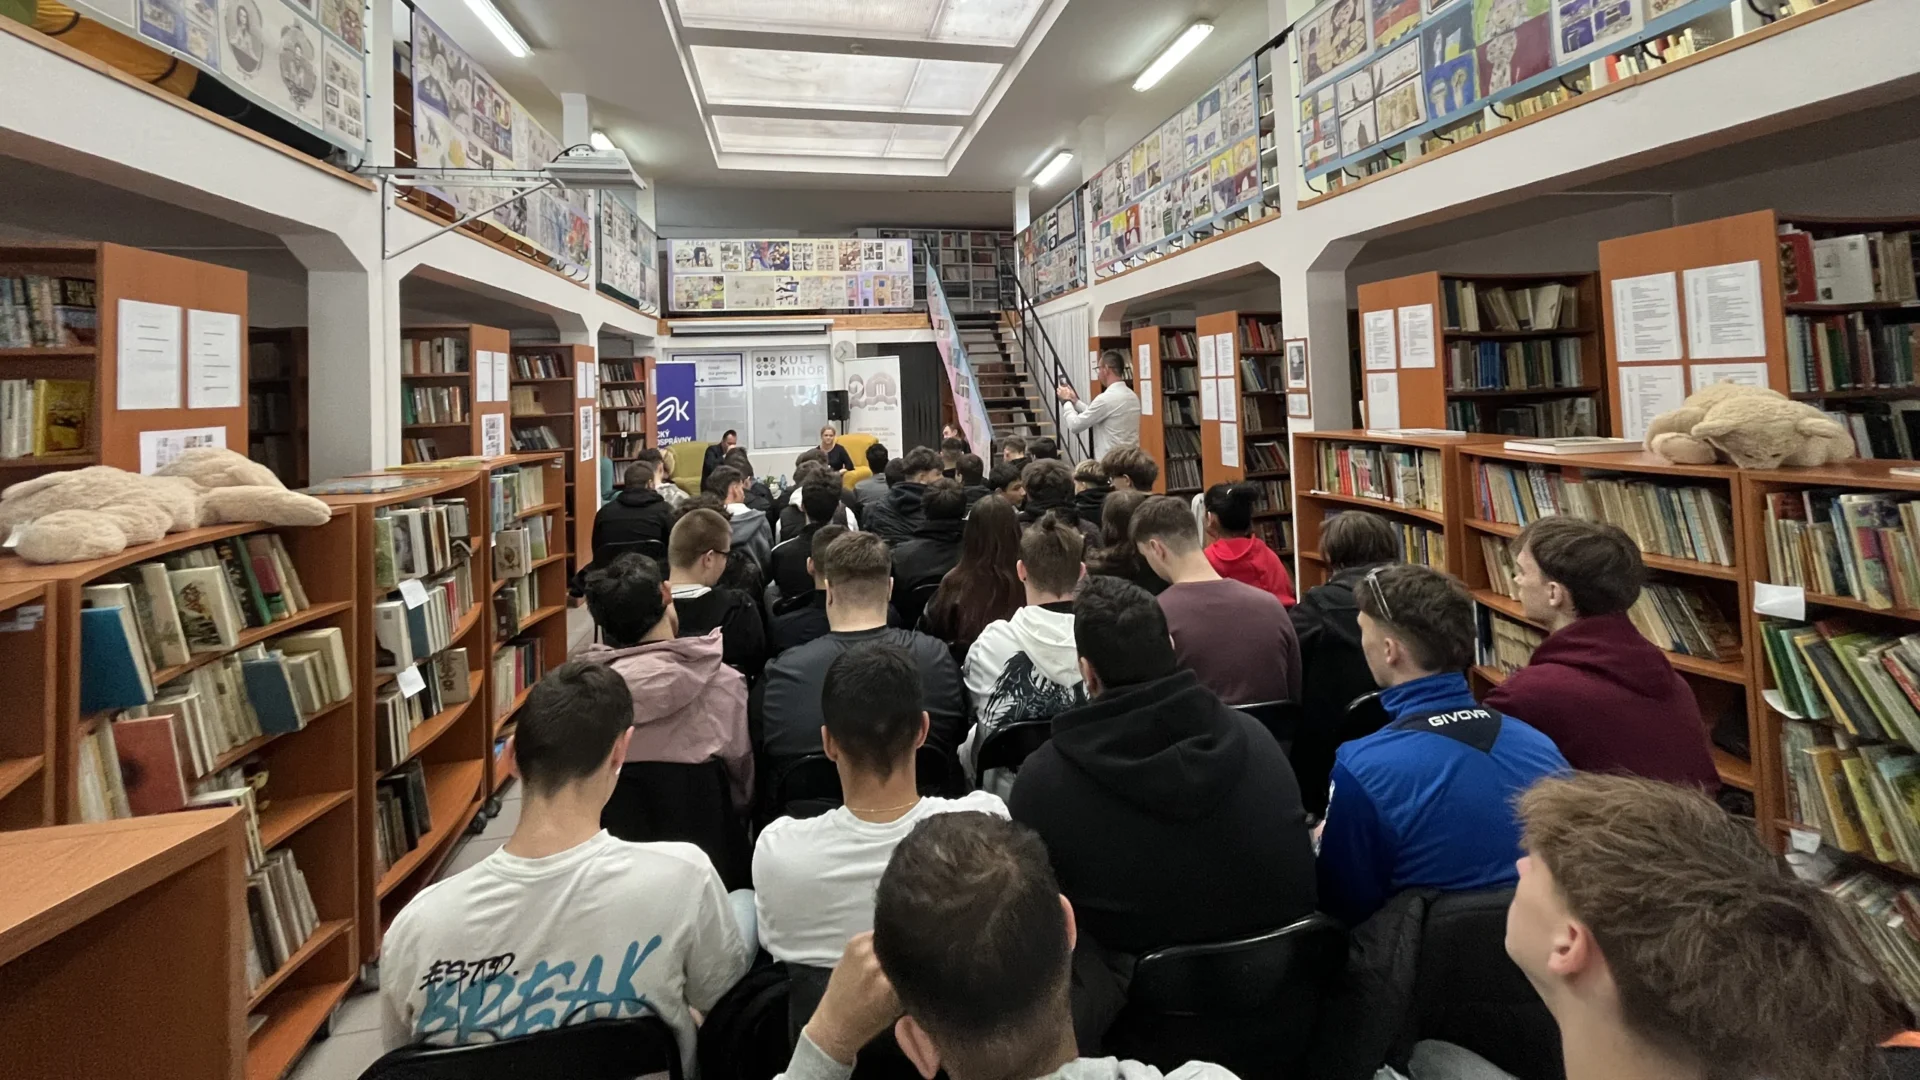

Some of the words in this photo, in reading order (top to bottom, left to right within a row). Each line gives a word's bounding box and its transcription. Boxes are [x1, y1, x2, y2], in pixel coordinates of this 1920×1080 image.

[779, 355, 814, 365] KULT
[780, 366, 824, 376] MINOR
[1428, 709, 1491, 727] GIVOVA
[418, 952, 520, 990] ESTD.
[416, 934, 663, 1046] BREAK
